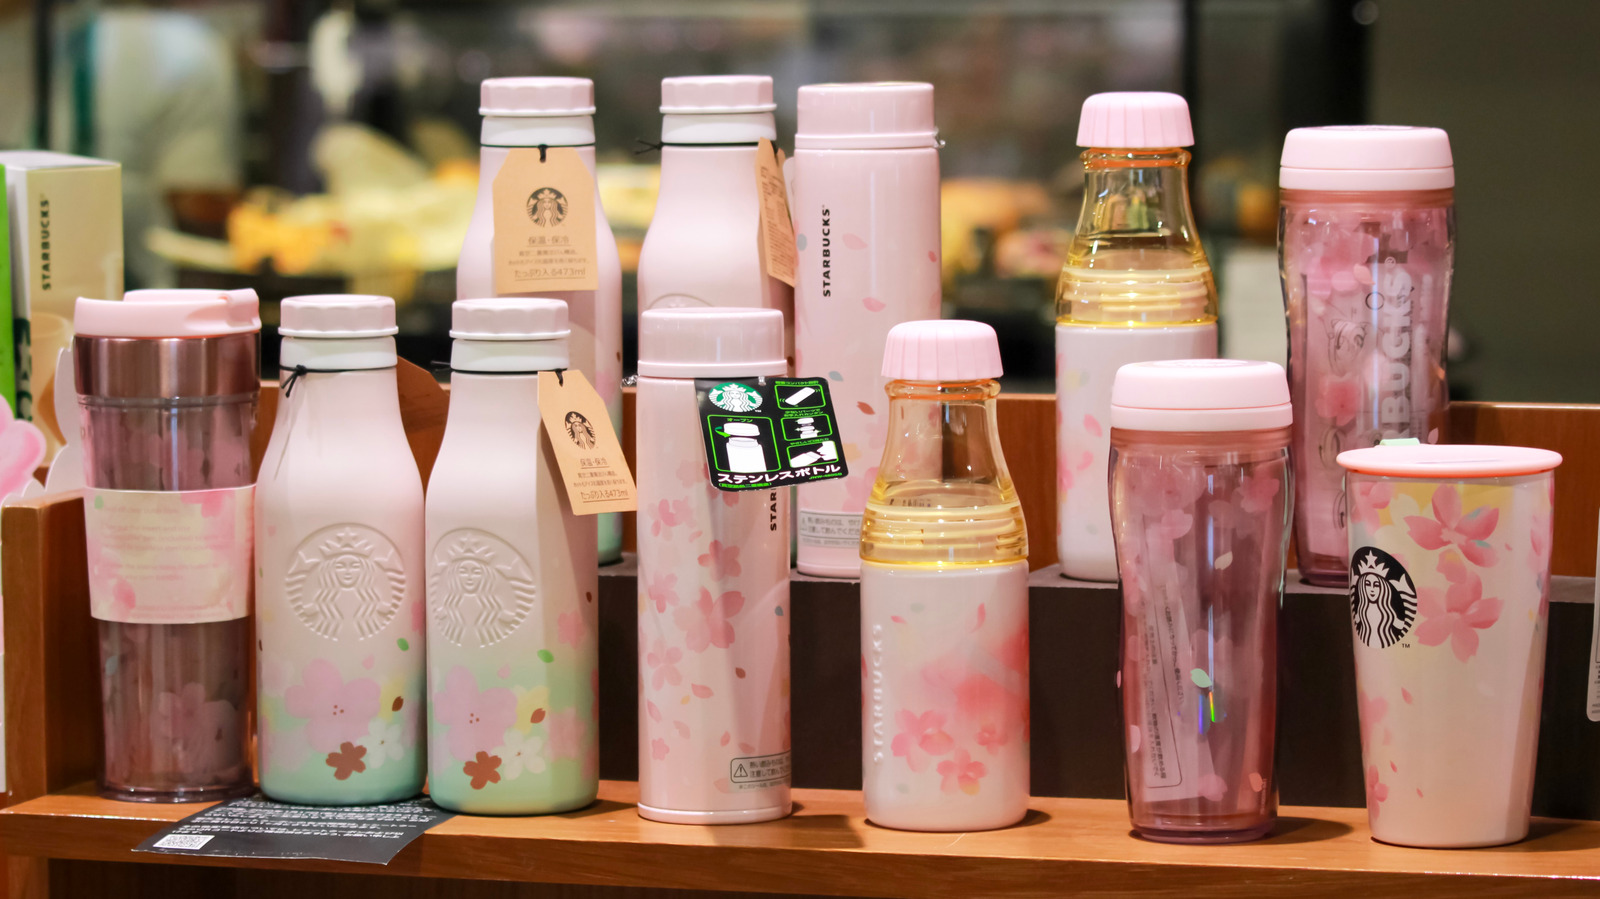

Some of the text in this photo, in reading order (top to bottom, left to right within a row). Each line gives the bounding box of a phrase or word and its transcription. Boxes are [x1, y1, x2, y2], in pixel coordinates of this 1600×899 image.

[41, 200, 50, 290] STARBUCKS
[822, 208, 831, 297] STARBUCKS
[717, 465, 841, 484] ステンレスボトル
[872, 624, 884, 765] STARBUCKS
